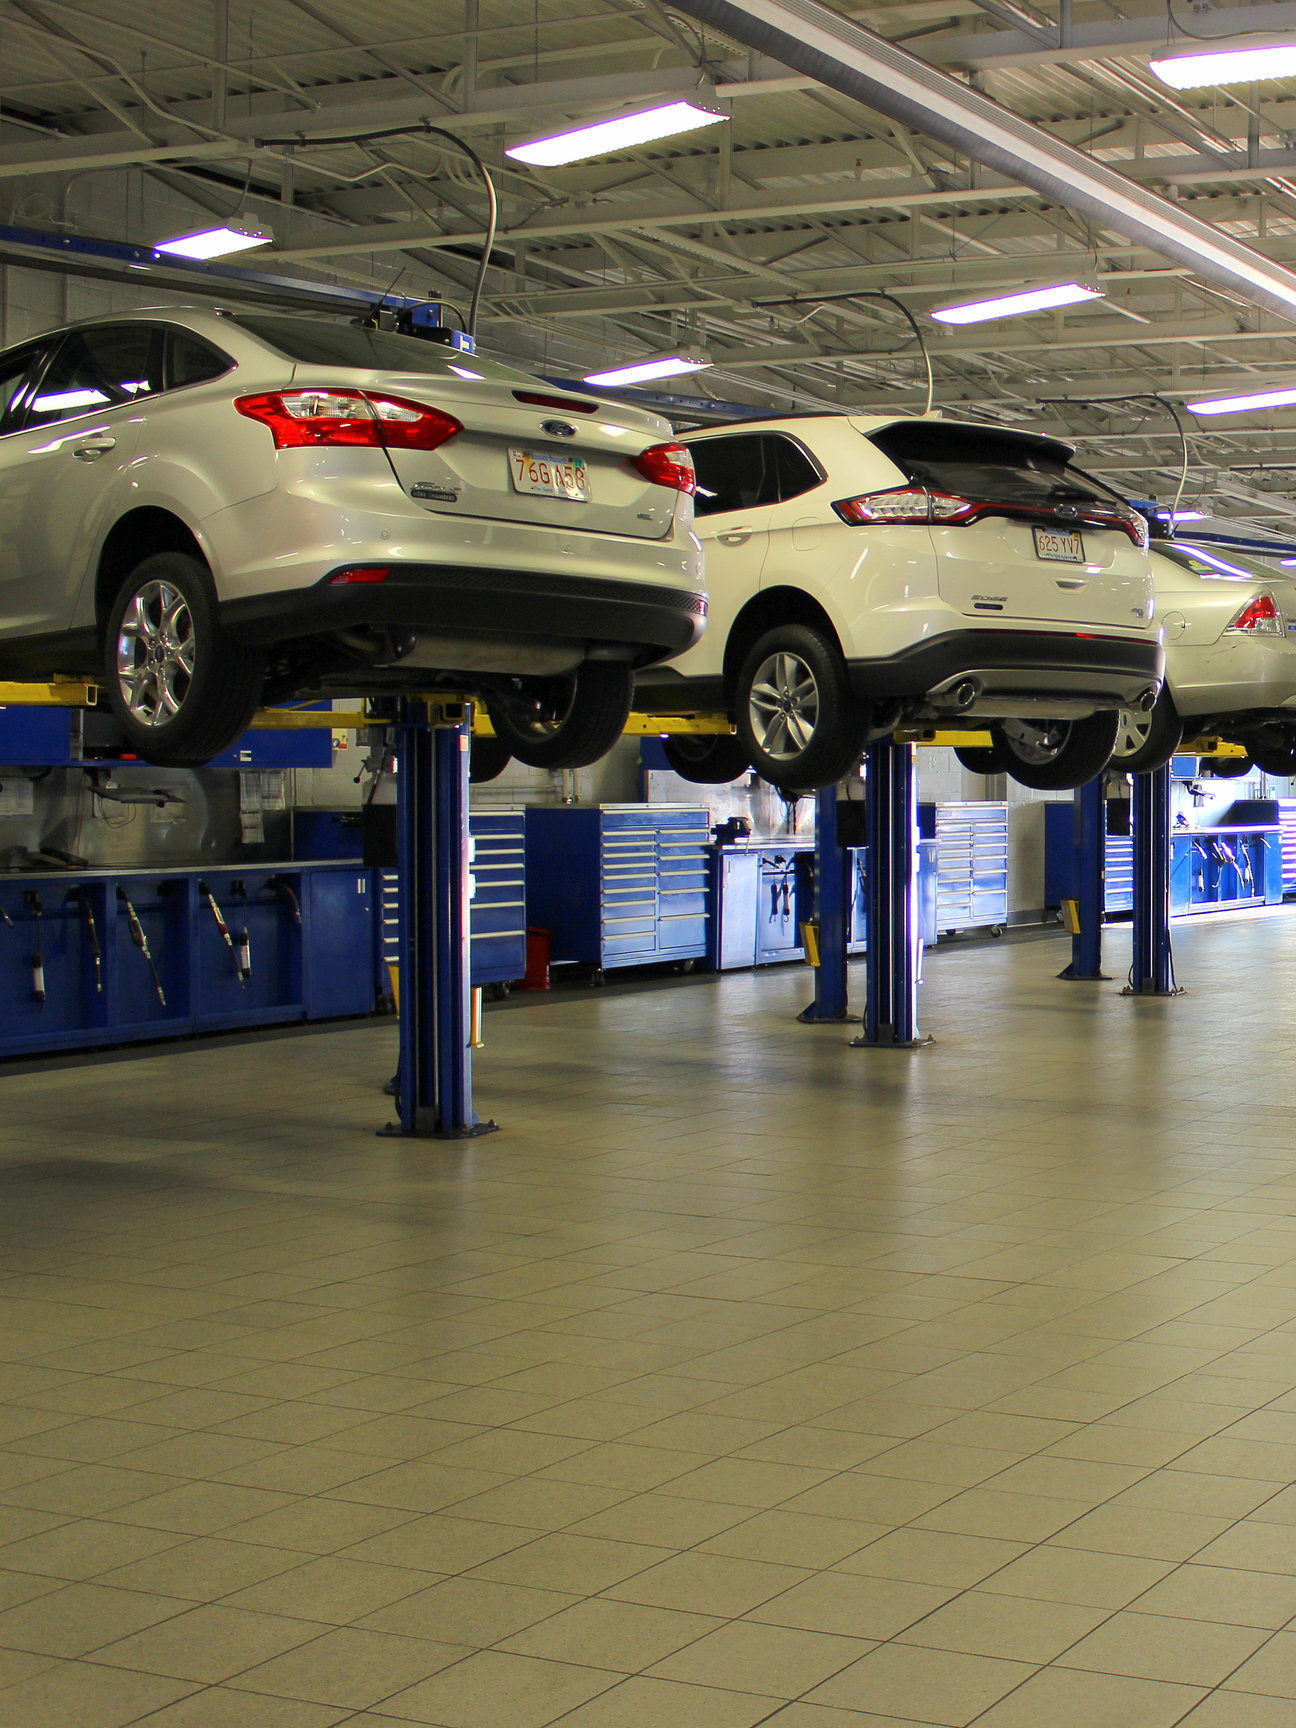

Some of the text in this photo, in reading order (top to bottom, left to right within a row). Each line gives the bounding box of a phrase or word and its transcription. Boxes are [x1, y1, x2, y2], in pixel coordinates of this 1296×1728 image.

[515, 459, 551, 484] 76G
[1039, 535, 1080, 555] 625 YV7
